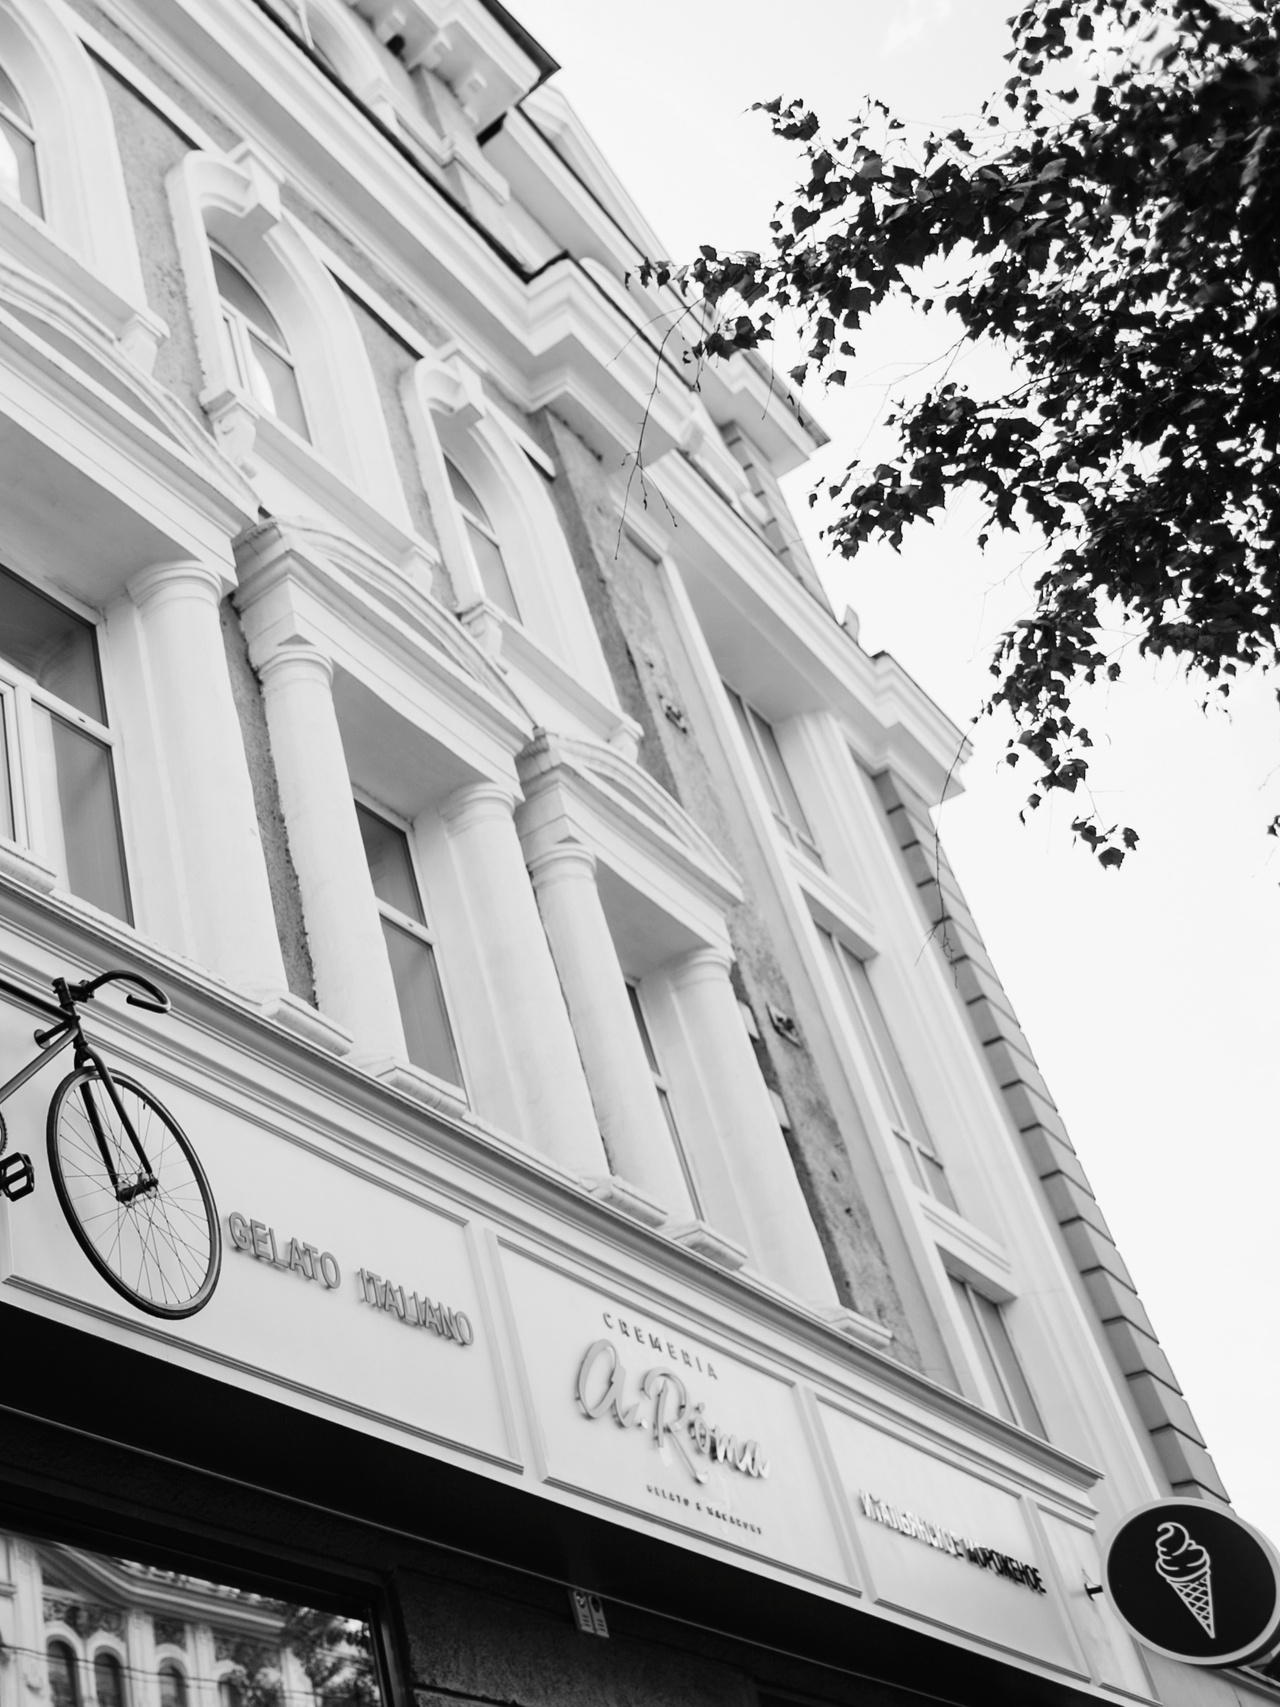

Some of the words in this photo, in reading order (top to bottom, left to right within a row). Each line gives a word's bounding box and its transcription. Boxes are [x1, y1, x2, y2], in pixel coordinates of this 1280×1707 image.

[228, 1211, 342, 1290] GELATO
[359, 1267, 475, 1347] ITALIANO
[602, 1312, 718, 1380] CREMERIA
